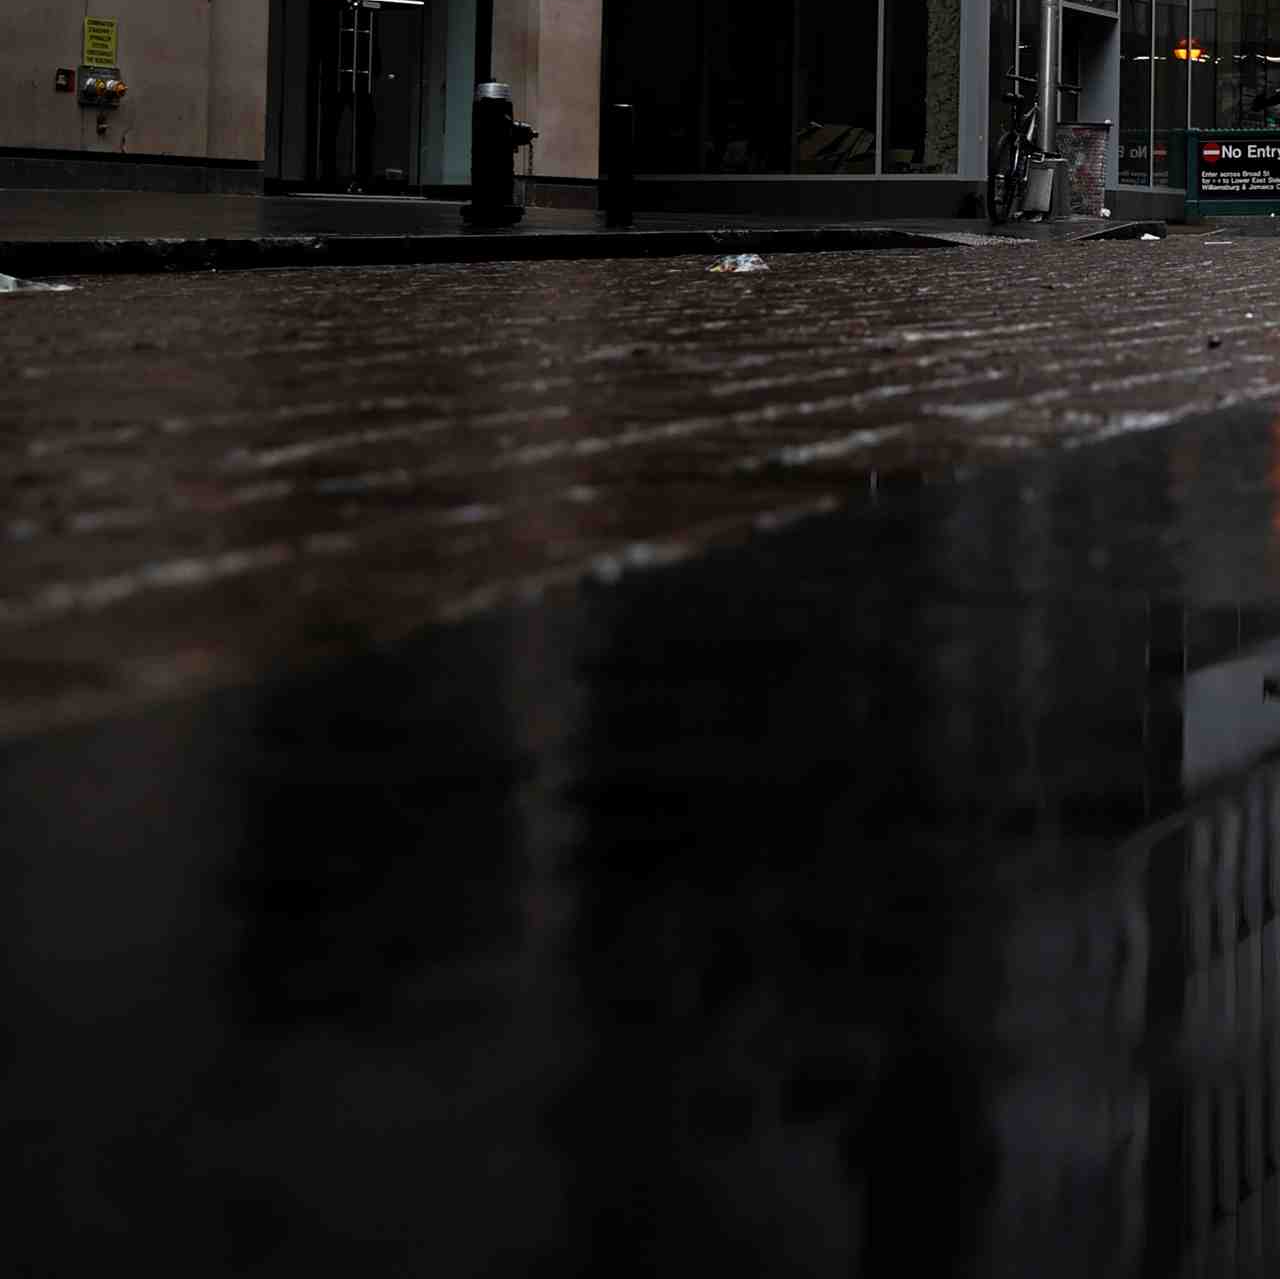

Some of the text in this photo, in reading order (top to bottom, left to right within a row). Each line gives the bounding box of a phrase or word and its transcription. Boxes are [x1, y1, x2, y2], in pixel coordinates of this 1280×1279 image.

[1221, 144, 1243, 159] No
[1242, 169, 1262, 178] Broad
[1231, 176, 1250, 184] Lower
[1251, 176, 1266, 184] East
